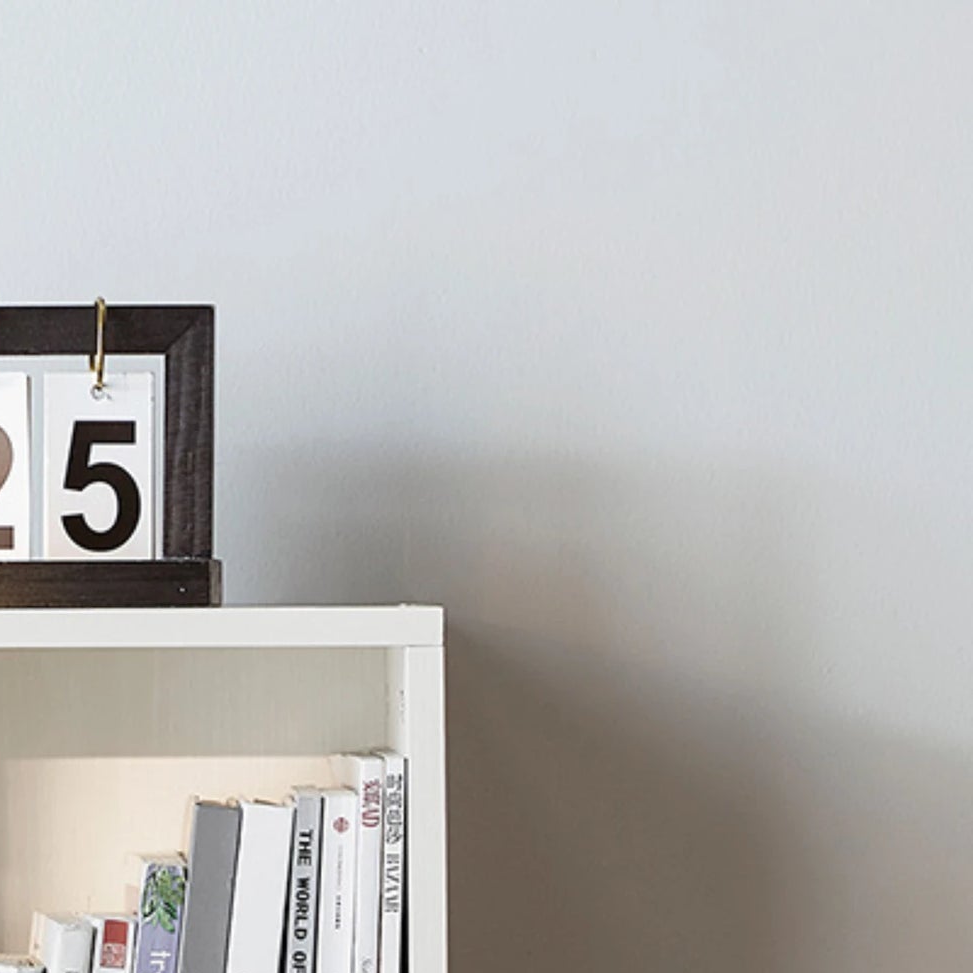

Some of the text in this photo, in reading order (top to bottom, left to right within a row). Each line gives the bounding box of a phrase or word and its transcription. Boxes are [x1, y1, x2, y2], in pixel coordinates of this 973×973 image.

[61, 419, 142, 553] 5
[296, 829, 314, 867] THE
[293, 877, 311, 940] WORLD
